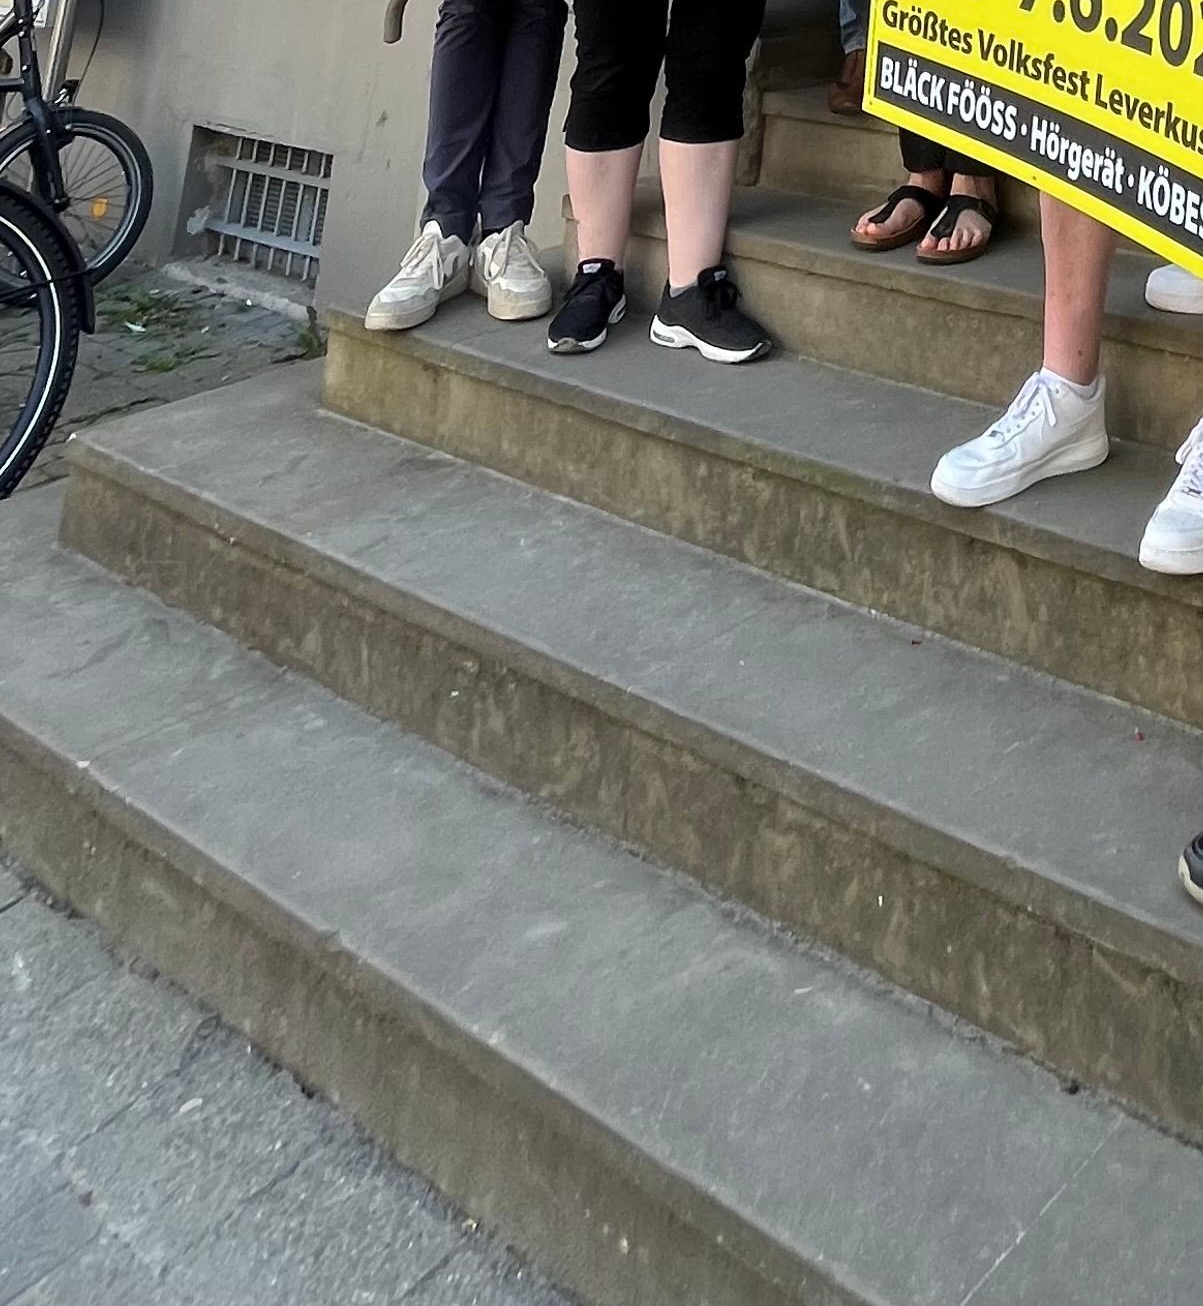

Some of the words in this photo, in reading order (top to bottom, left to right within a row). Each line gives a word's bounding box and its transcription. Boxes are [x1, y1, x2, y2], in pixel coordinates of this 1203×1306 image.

[977, 27, 1091, 102] Volksfest
[880, 55, 946, 113] BLÄCK
[947, 78, 1018, 142] FÖÖSS
[1030, 114, 1124, 195] Hörgerät
